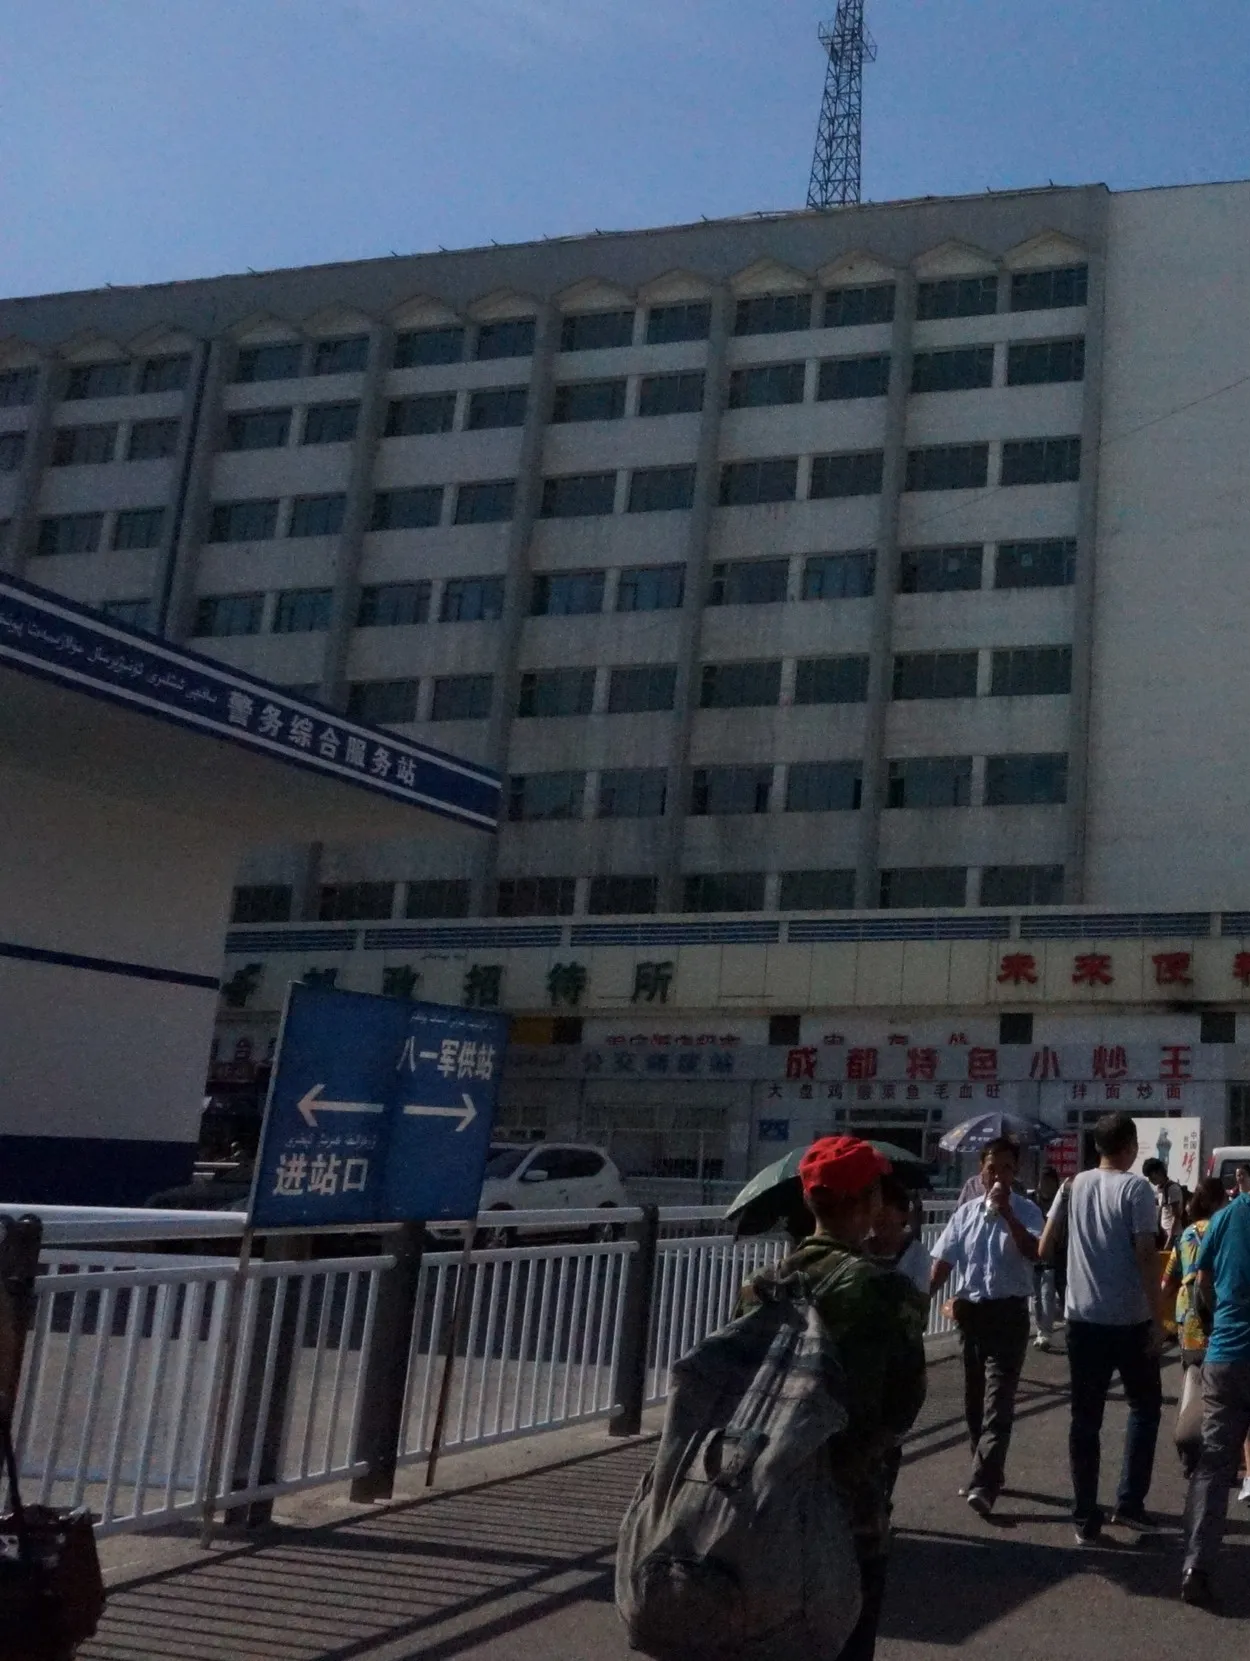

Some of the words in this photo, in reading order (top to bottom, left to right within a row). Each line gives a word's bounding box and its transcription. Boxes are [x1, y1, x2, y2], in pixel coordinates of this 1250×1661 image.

[227, 690, 416, 787] 警务综合服务站
[397, 1036, 497, 1081] 八一军供站
[786, 1044, 1194, 1081] 成都特色小炒王
[1072, 1082, 1183, 1101] 拌面炒面
[272, 1153, 370, 1197] 进站口
